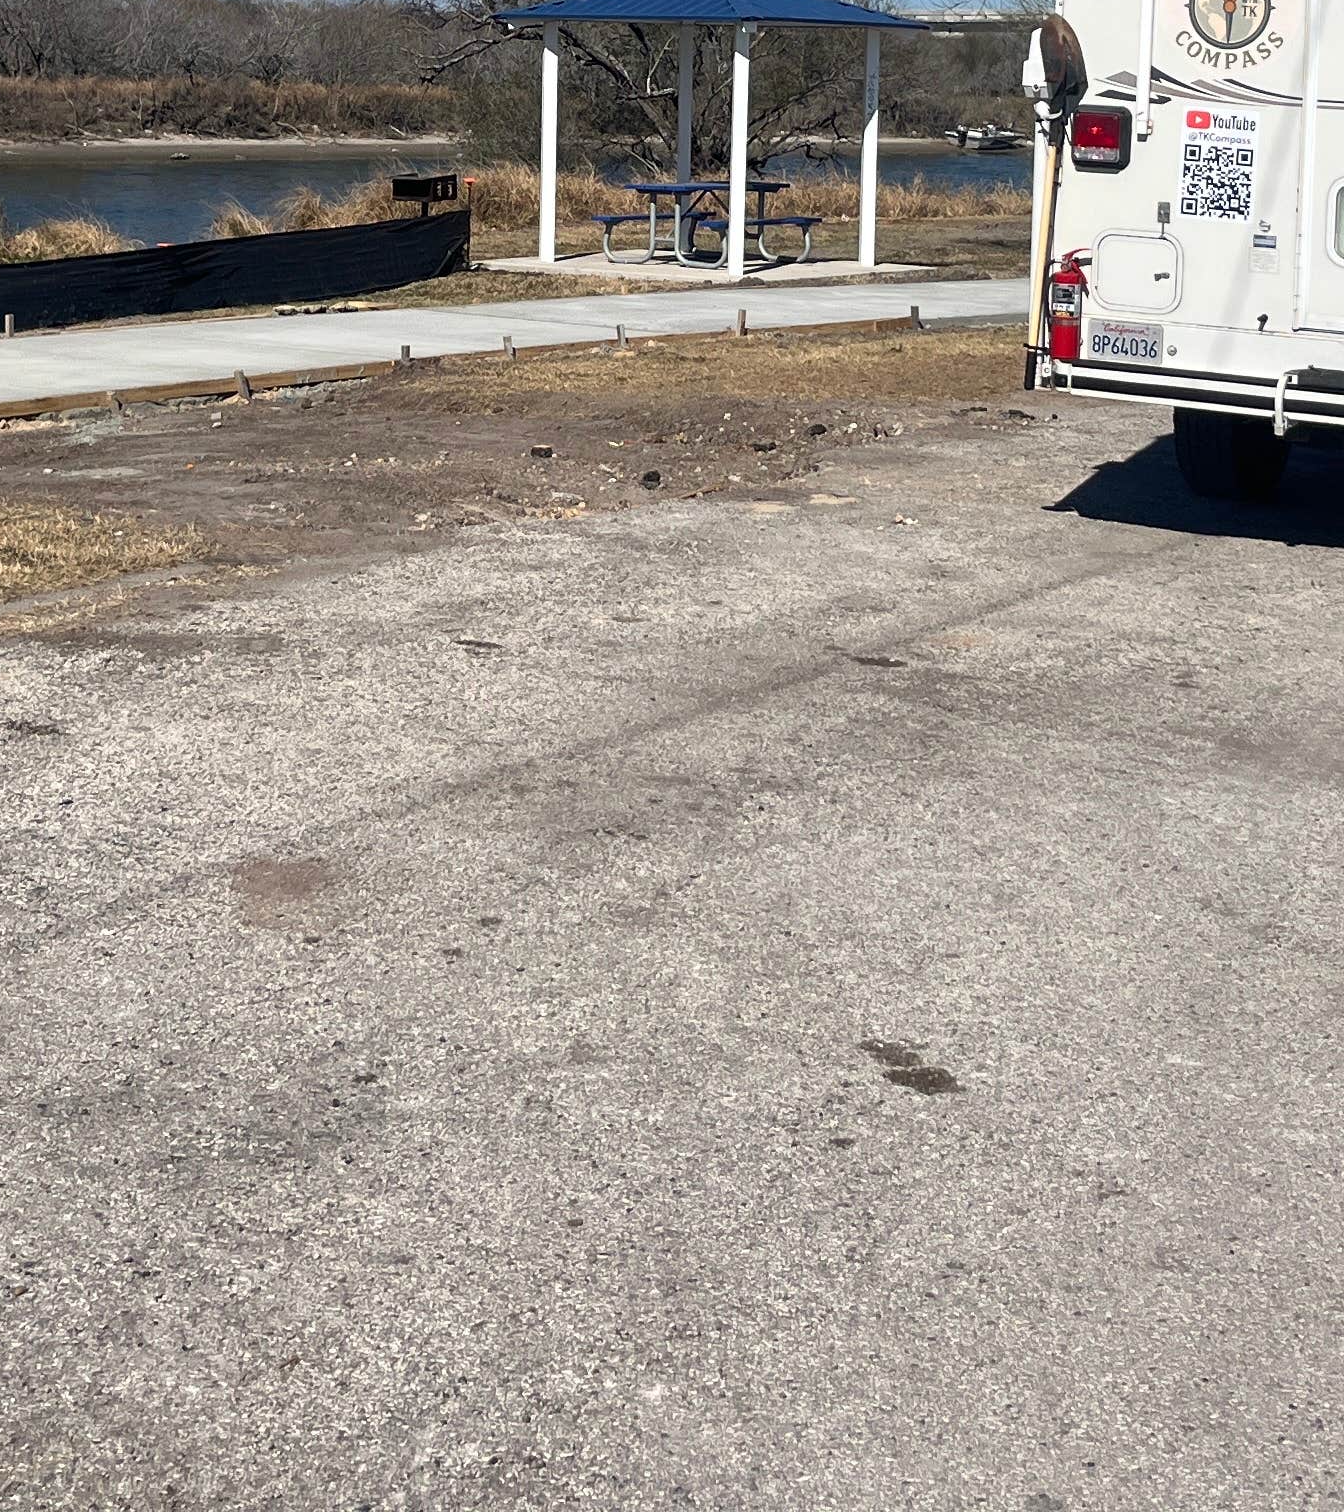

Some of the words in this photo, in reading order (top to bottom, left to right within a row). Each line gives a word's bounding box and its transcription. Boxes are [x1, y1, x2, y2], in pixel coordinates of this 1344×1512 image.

[1241, 5, 1258, 17] TK
[1175, 30, 1284, 70] COMPASS
[1212, 114, 1256, 131] YouTube
[1188, 131, 1251, 144] @TKCompass
[1092, 334, 1158, 358] 8P64036
